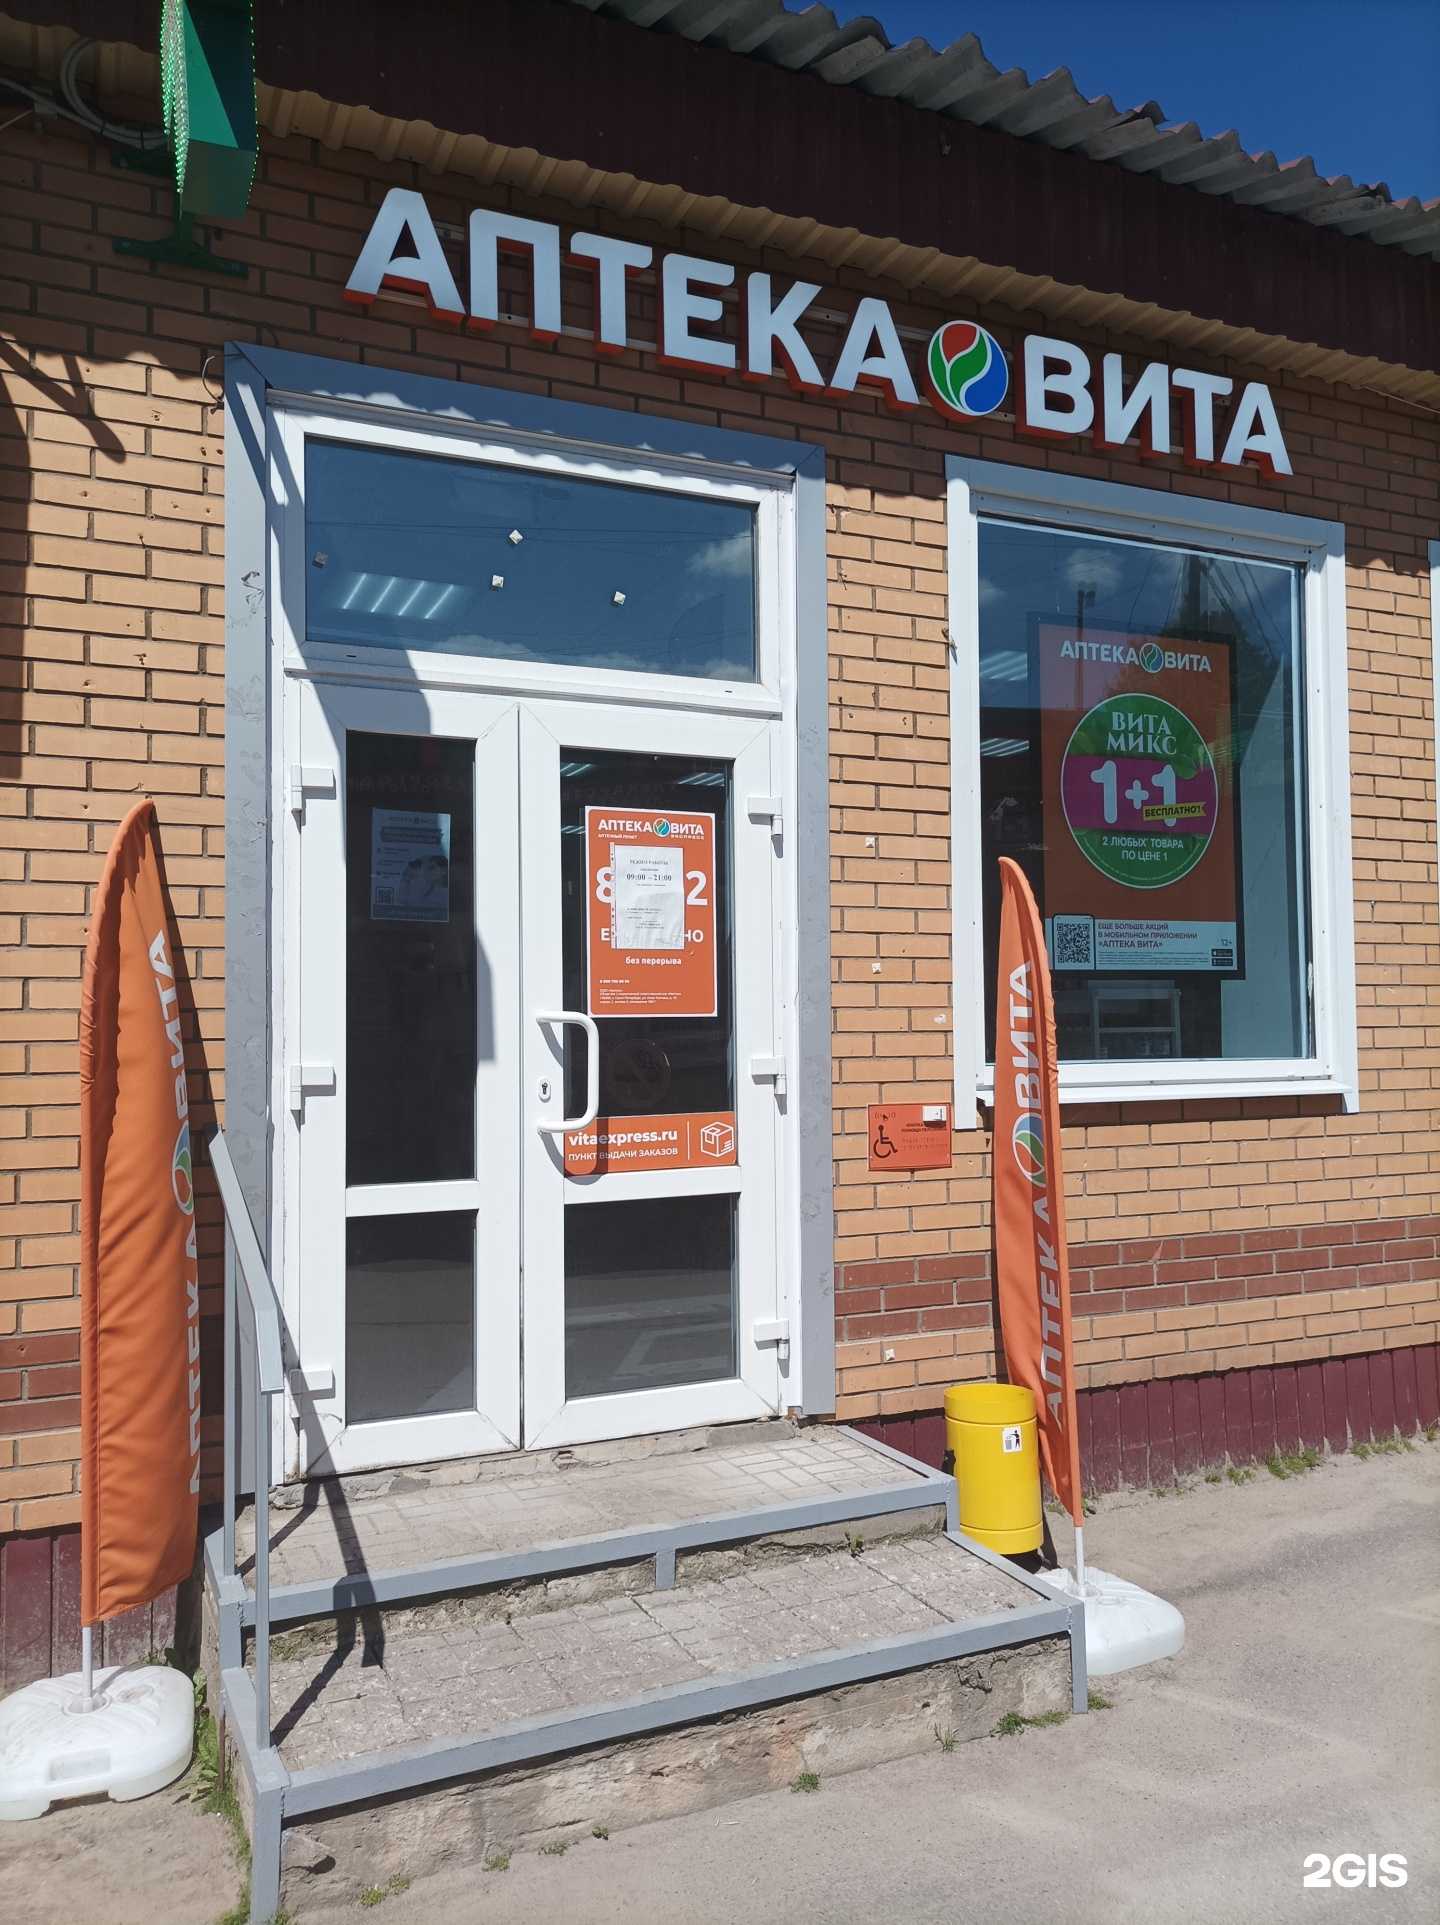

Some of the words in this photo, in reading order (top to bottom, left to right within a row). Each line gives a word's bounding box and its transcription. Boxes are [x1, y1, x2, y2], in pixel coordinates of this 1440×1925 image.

[344, 187, 920, 405] АПТЕКА
[1023, 333, 1294, 477] ВИТА
[1060, 640, 1139, 665] АПТЕКА
[1165, 652, 1212, 673] ВИТА
[1112, 711, 1172, 735] ВИТА
[1107, 732, 1177, 755] МИКС
[598, 819, 653, 833] АПТЕКА
[670, 822, 704, 835] ВИТА
[1103, 836, 1109, 846] 2
[1150, 838, 1184, 849] ТОВАРА
[1122, 850, 1135, 860] ПО
[1138, 850, 1161, 861] ЦЕНЕ
[626, 873, 646, 881] 09:00
[625, 956, 640, 965] без
[641, 957, 682, 966] перерыва
[1009, 959, 1042, 1109] ВИТА
[568, 1130, 678, 1146] vitaexpress.ru
[568, 1152, 597, 1161] ПУНКТ
[599, 1150, 637, 1161] ВЫДАЧИ
[638, 1147, 678, 1158] ЗАКАЗОВ
